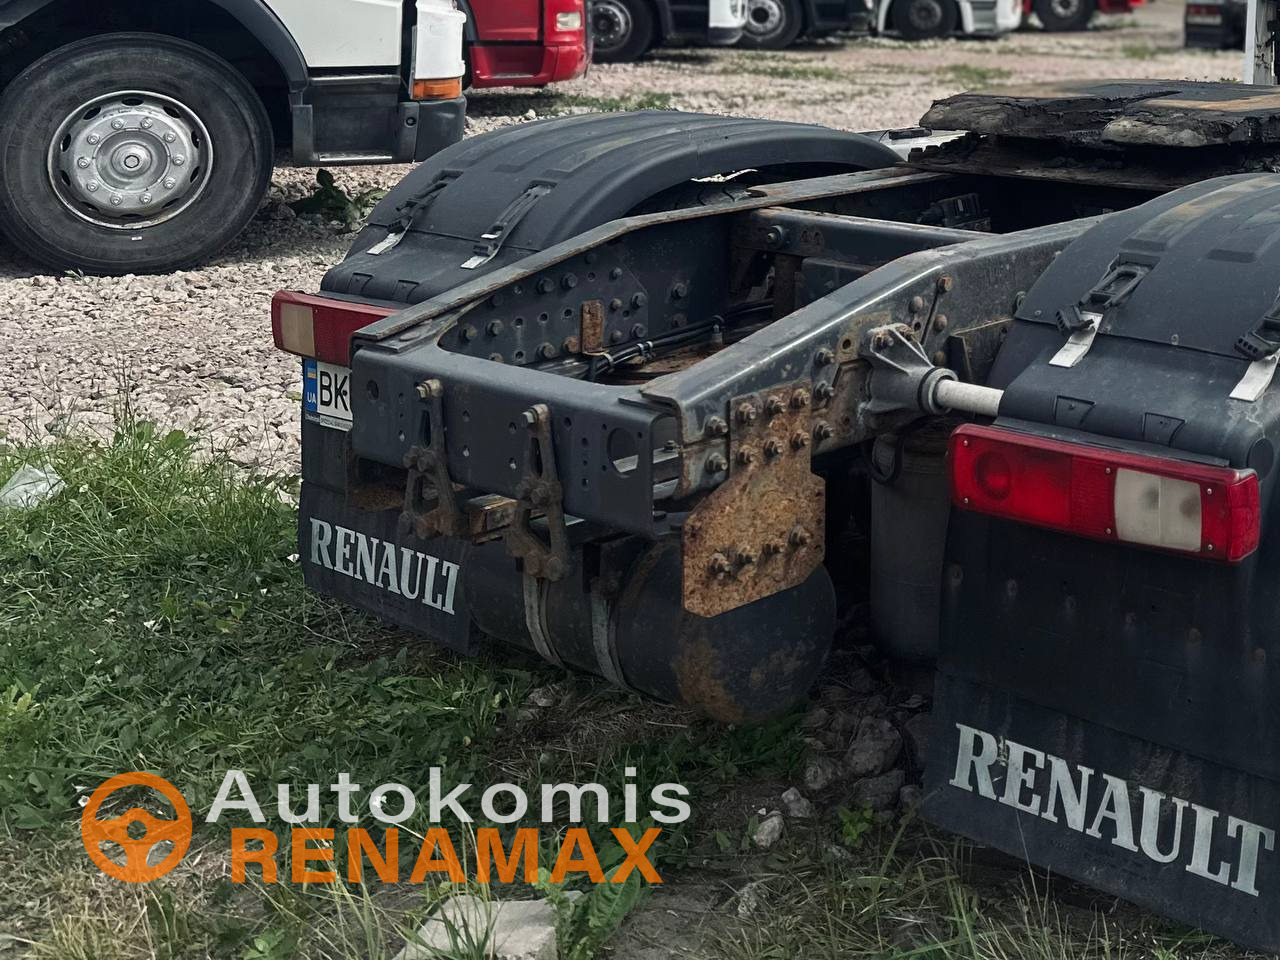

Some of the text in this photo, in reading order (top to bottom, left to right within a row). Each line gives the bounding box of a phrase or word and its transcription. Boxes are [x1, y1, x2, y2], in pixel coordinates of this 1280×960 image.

[307, 370, 349, 412] UA BK
[310, 517, 460, 616] RENAULT
[949, 722, 1276, 897] RENAULT
